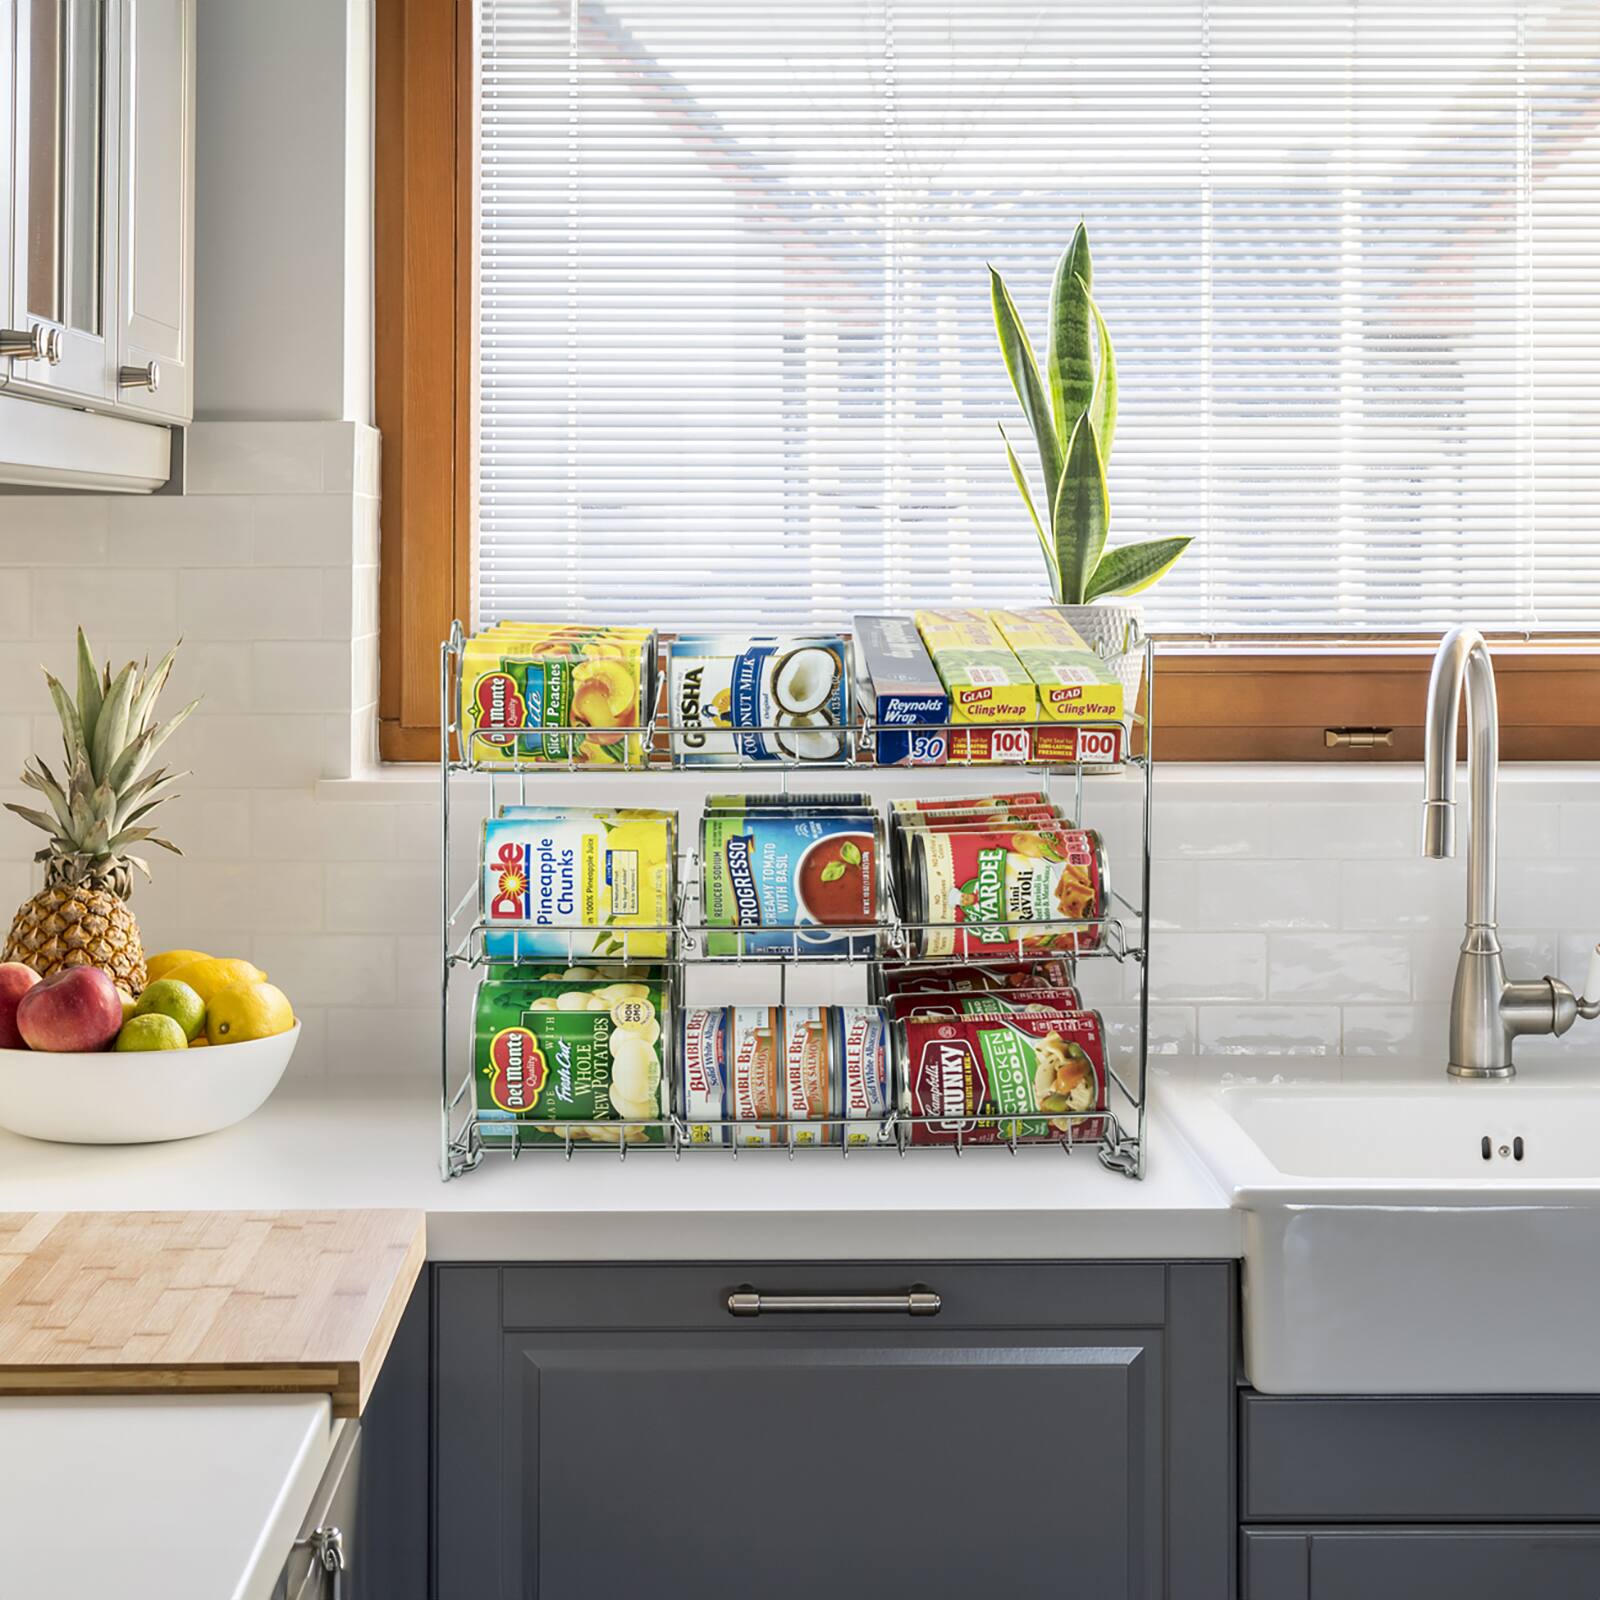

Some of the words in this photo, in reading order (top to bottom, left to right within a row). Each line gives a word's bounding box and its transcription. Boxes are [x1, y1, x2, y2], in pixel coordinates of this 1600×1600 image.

[739, 657, 756, 691] MILK
[490, 678, 506, 721] Monte
[546, 663, 561, 717] Peaches
[762, 692, 770, 719] Original
[961, 689, 991, 703] GLAD
[1052, 688, 1081, 702] GLAD
[507, 698, 518, 727] Quality
[884, 711, 917, 725] Wrap
[887, 698, 943, 714] Reynolds
[490, 721, 506, 743] Dl
[994, 733, 1027, 752] 100
[1081, 735, 1113, 754] 100
[913, 737, 945, 760] 30
[587, 854, 597, 894] Pineapple
[713, 850, 723, 880] SODIUM
[762, 842, 776, 882] TOMATO
[776, 853, 789, 884] BASIL
[490, 843, 526, 919] Dole
[536, 838, 557, 925] Pineapple
[557, 849, 574, 914] Chunks
[728, 841, 758, 926] PROGRESSO
[586, 895, 594, 915] 100%
[713, 882, 723, 918] REDUCED
[763, 883, 778, 925] CREAMY
[777, 883, 790, 914] WITH
[1010, 885, 1020, 912] Mini
[625, 1003, 633, 1022] NON
[633, 1003, 641, 1022] GMO
[686, 1009, 706, 1030] BEE
[545, 1016, 556, 1050] WITH
[788, 1030, 806, 1054] BEE
[847, 1022, 865, 1046] BEE
[865, 1026, 878, 1058] Albacore
[506, 1032, 524, 1080] Monte
[592, 1017, 609, 1089] POTATOES
[687, 1032, 707, 1092] BUMBLE
[703, 1041, 714, 1065] White
[737, 1040, 755, 1064] BEE
[755, 1047, 768, 1087] SALMON
[807, 1039, 819, 1078] SALMON
[525, 1056, 538, 1087] Quality
[574, 1044, 592, 1096] WHOLE
[706, 1066, 718, 1087] Solid
[789, 1055, 807, 1111] BUMBLE
[847, 1048, 867, 1109] BUMBLE
[865, 1059, 877, 1084] White
[990, 1033, 1017, 1115] CHICKEN
[1003, 1031, 1028, 1113] NOODLE
[506, 1081, 524, 1107] Del
[737, 1065, 756, 1119] BUMBLE
[867, 1085, 880, 1105] Solid
[940, 1045, 967, 1129] CHUNKY
[592, 1090, 610, 1120] NEW
